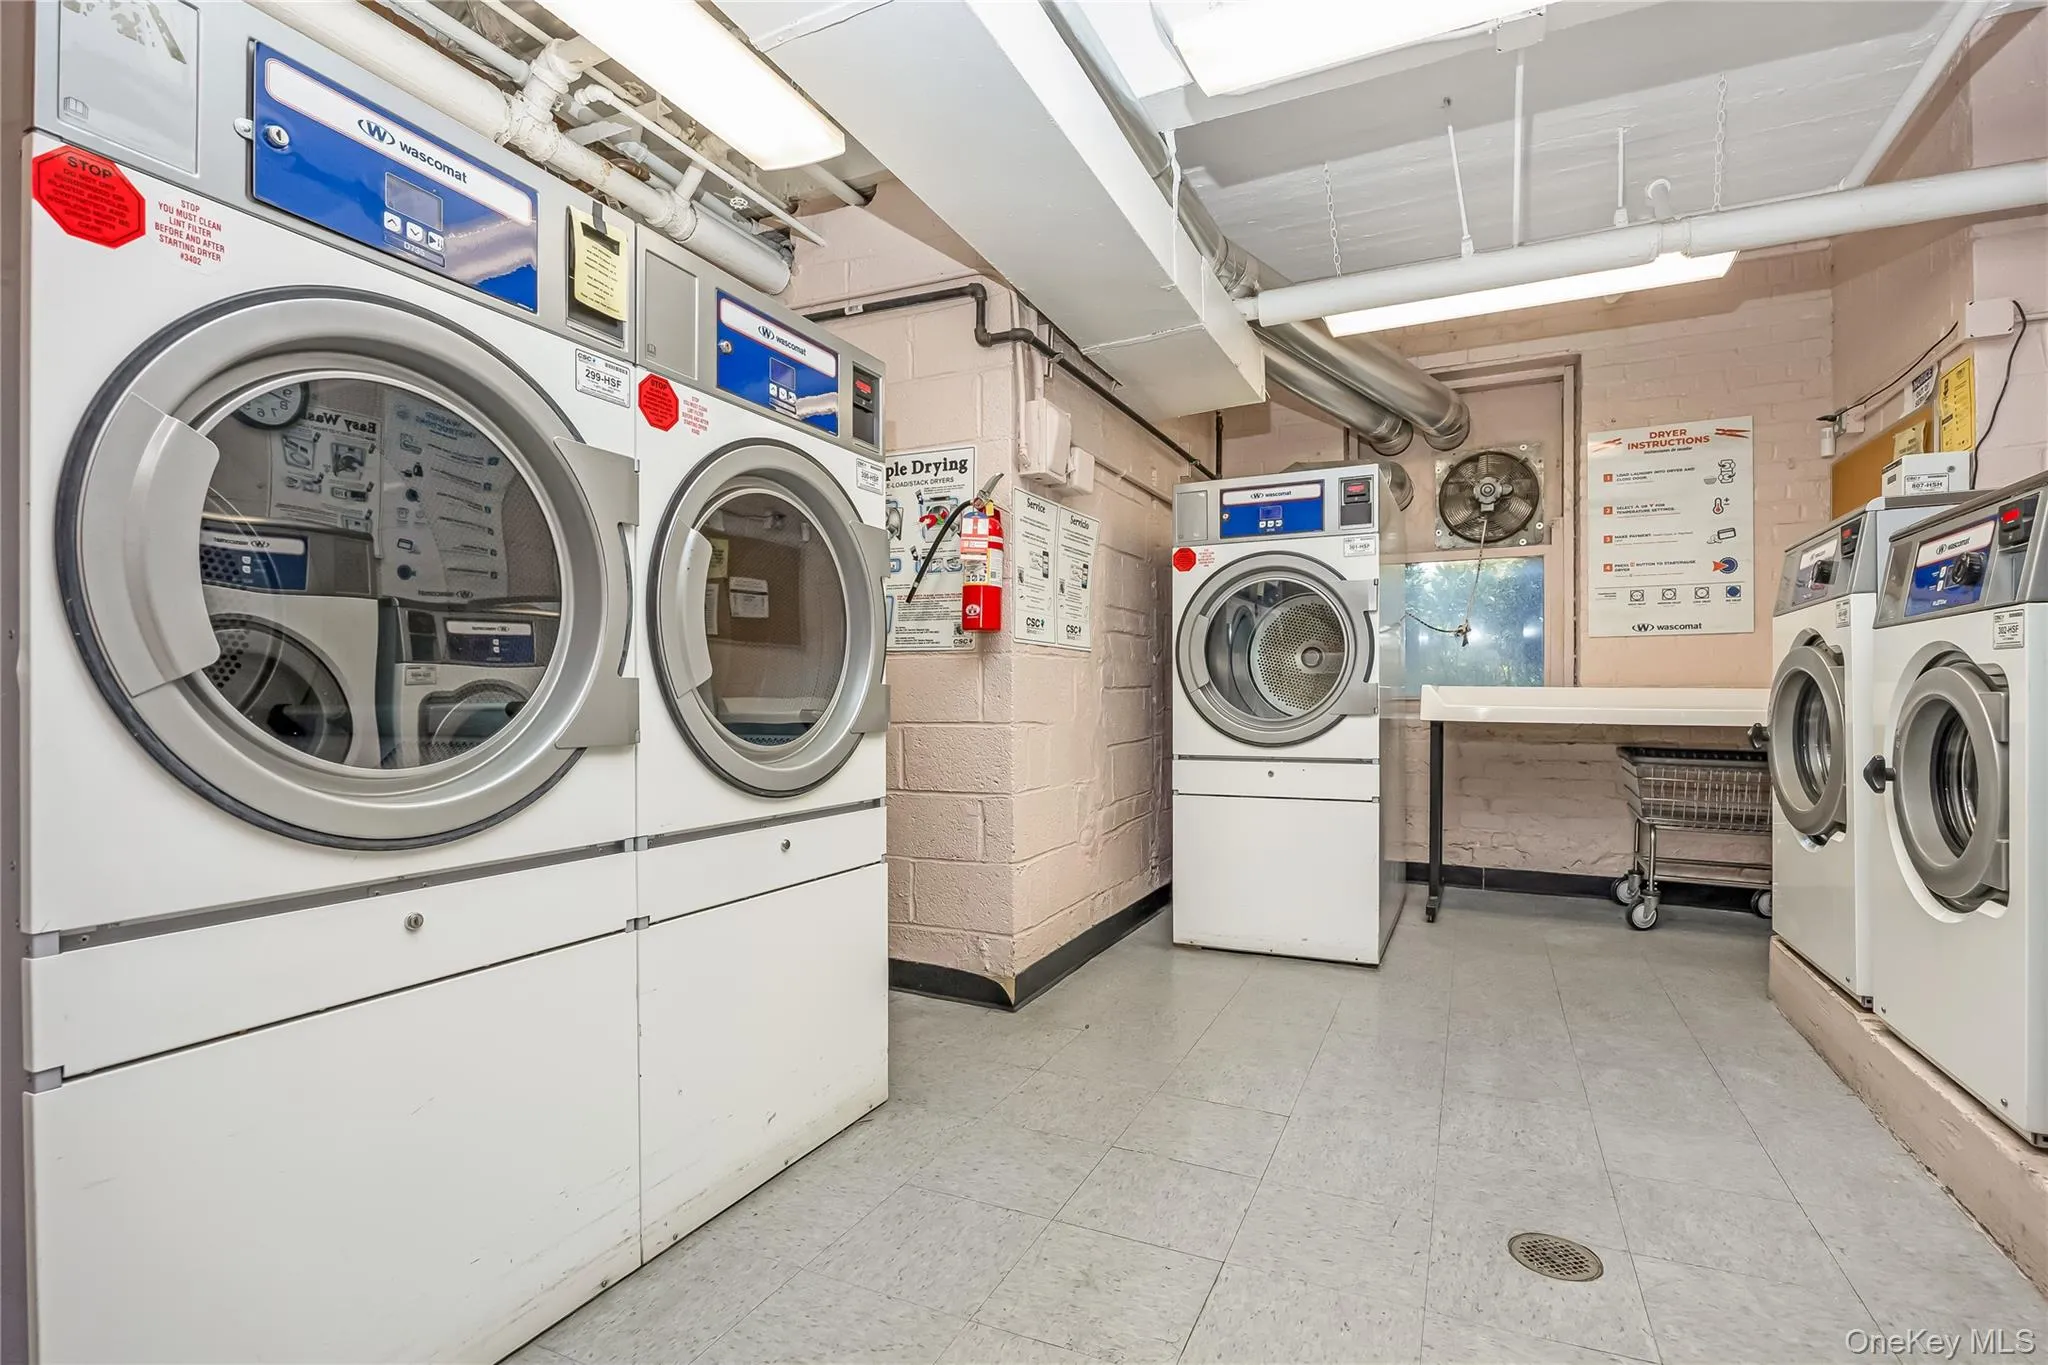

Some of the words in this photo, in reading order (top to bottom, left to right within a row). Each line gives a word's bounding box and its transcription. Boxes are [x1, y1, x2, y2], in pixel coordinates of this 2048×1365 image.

[68, 156, 112, 178] STOP
[400, 141, 468, 183] wascomat
[180, 200, 200, 212] STOP
[158, 201, 174, 214] YOU
[176, 208, 196, 222] MUST
[199, 217, 221, 232] CLEAN
[170, 216, 185, 228] LINT
[188, 223, 212, 238] FILTER
[154, 222, 184, 239] BEFORE
[186, 233, 200, 244] AND
[203, 240, 224, 253] AFTER
[159, 234, 195, 254] STARTING
[198, 247, 221, 262] DRYER
[180, 253, 202, 266] #3402
[776, 336, 806, 356] wascomat
[586, 369, 622, 388] 299-HSF
[1628, 436, 1710, 450] INSTRUCTIONS
[1650, 429, 1687, 439] DRYER
[912, 458, 968, 477] Drying
[1027, 498, 1045, 513] Service
[1026, 617, 1040, 628] CSC
[1066, 625, 1078, 634] CSC
